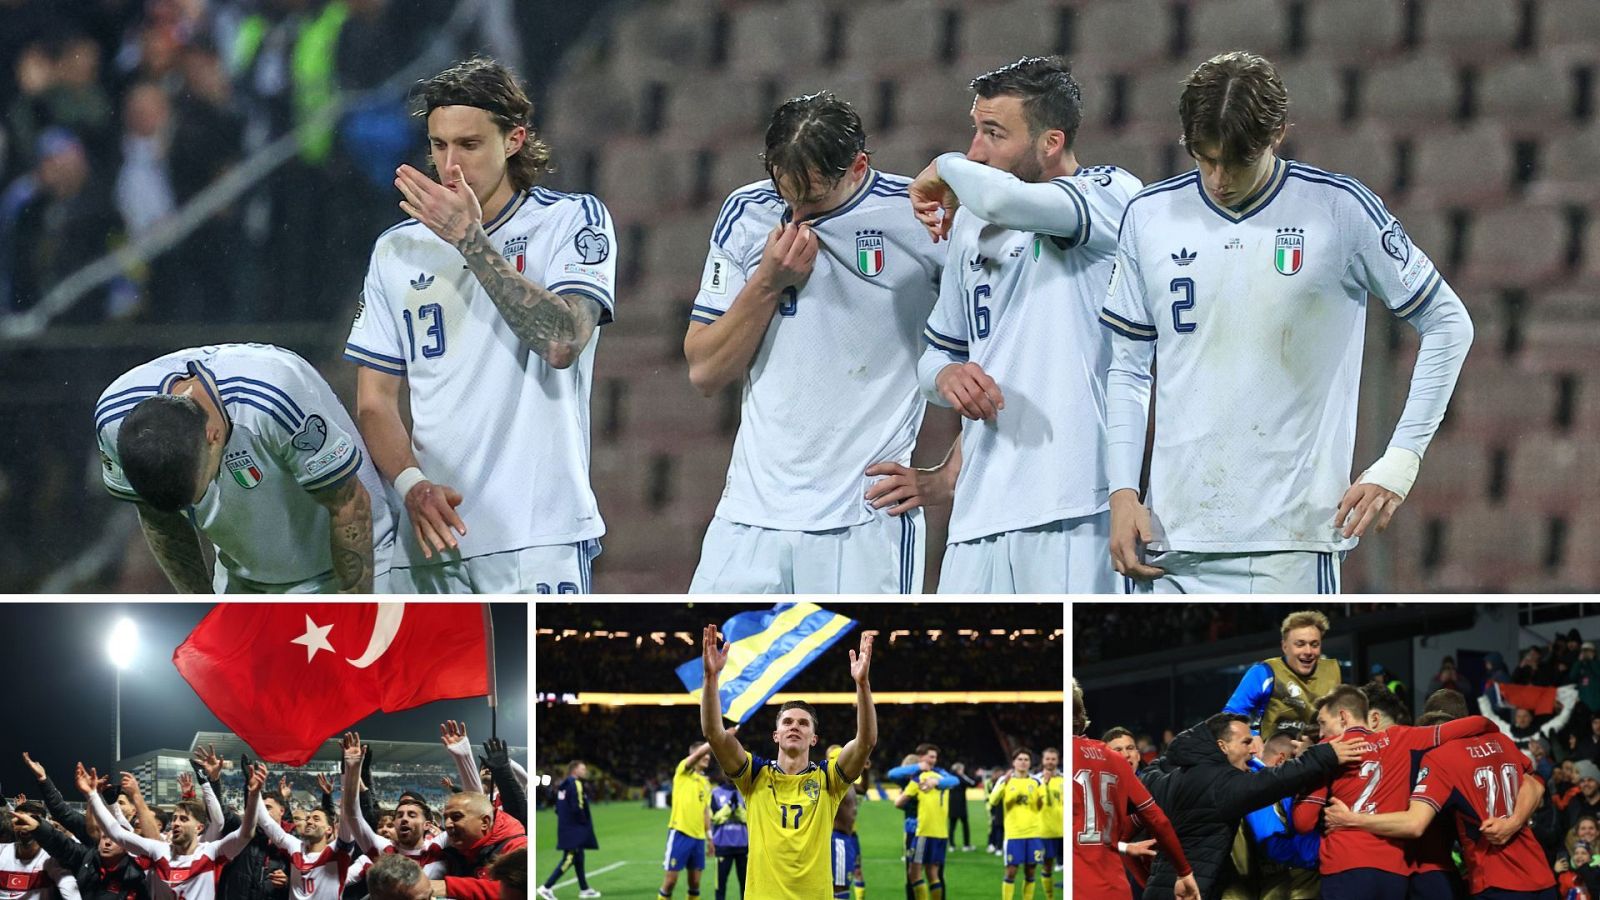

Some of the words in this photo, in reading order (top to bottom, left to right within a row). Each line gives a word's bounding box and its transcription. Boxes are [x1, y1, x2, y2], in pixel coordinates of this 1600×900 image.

[504, 244, 524, 256] ITALIA
[859, 239, 881, 247] ITALIA
[1277, 237, 1301, 246] ITALIA
[1170, 277, 1197, 333] 2
[403, 303, 445, 362] 13
[229, 458, 252, 470] ITALIA
[1352, 760, 1382, 814] 2
[1474, 763, 1520, 818] 20
[780, 804, 803, 830] 17
[1074, 769, 1118, 846] 15
